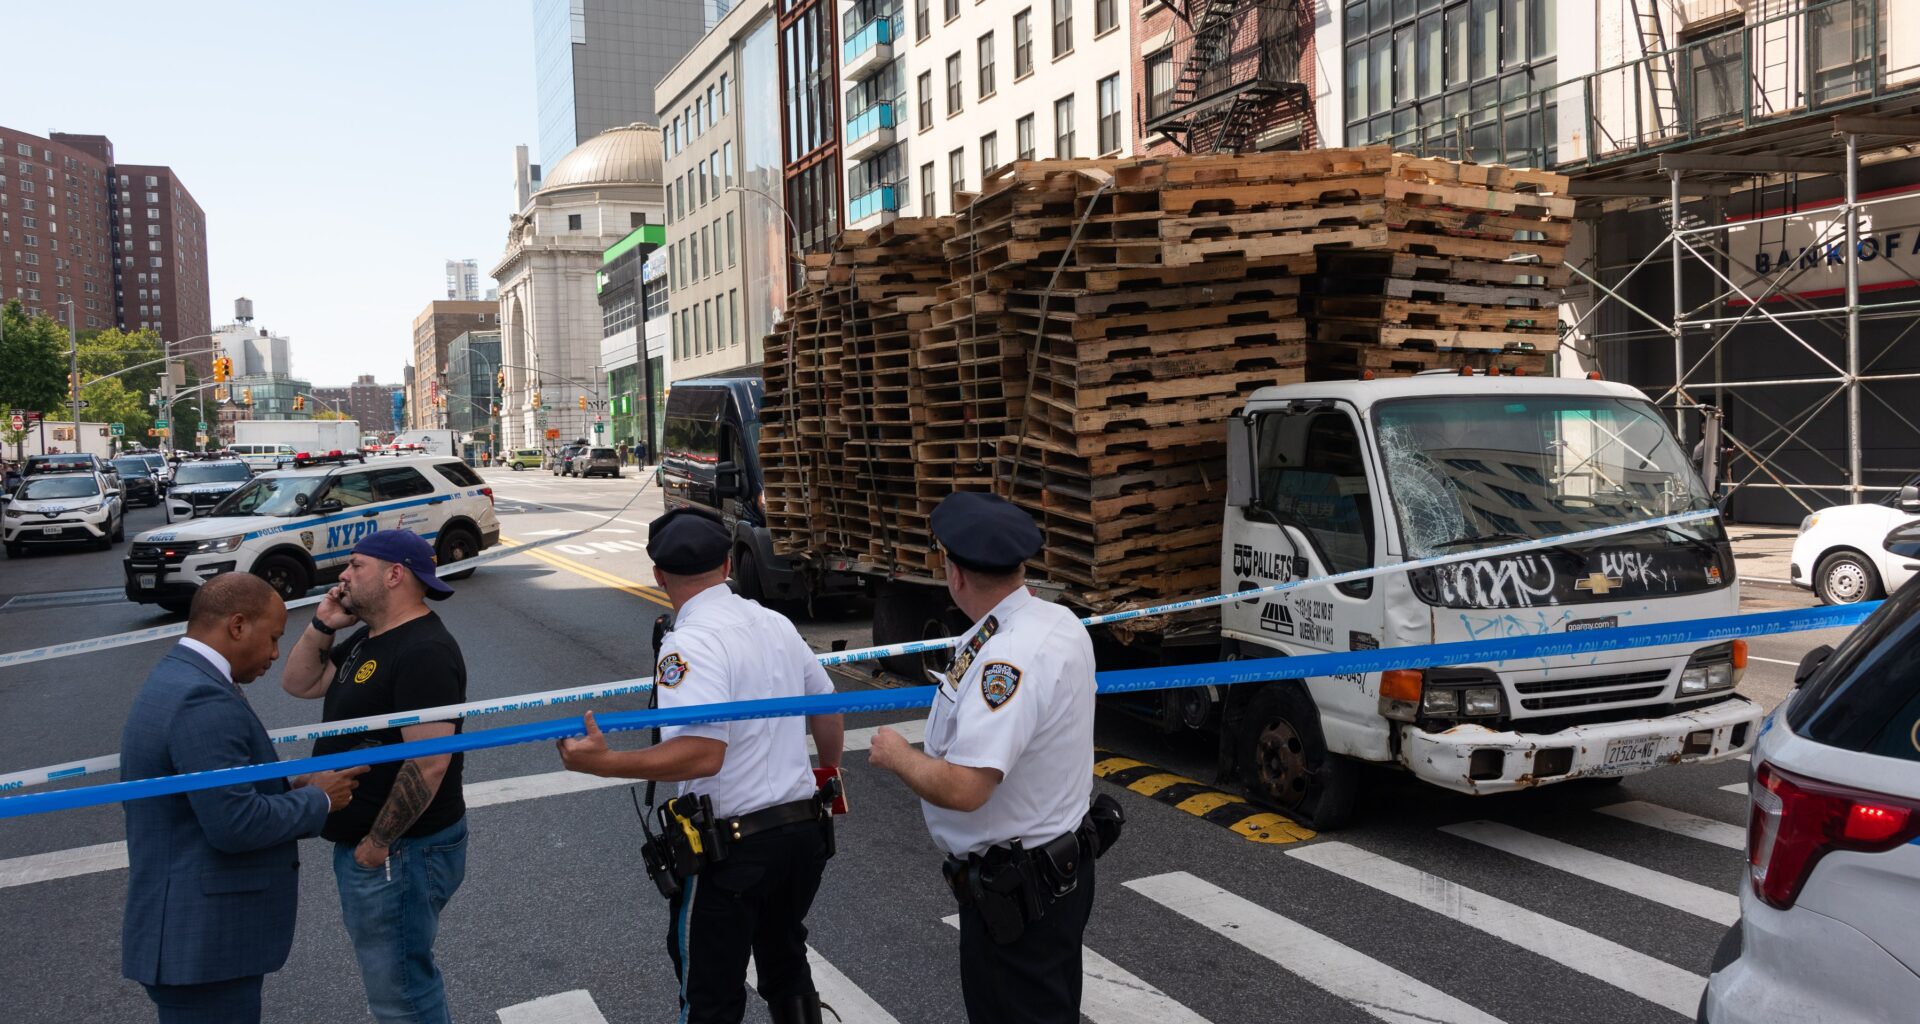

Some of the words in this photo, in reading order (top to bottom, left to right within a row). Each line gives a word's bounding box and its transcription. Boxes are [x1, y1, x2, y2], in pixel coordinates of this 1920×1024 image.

[1756, 241, 1845, 275] BANK
[1856, 232, 1901, 261] OF
[257, 526, 284, 537] POLICE
[326, 519, 378, 549] NYPD
[1235, 555, 1241, 567] B
[1243, 556, 1251, 569] W
[1253, 550, 1292, 582] PALLETS
[1328, 603, 1334, 621] ST
[660, 655, 678, 669] NYPD
[992, 664, 1012, 672] POLICE
[551, 695, 576, 704] POLICE
[578, 692, 594, 701] LINE
[602, 690, 613, 698] DO
[614, 687, 628, 696] NOT
[629, 684, 653, 693] CROSS
[307, 732, 319, 740] DO
[321, 729, 338, 737] NOT
